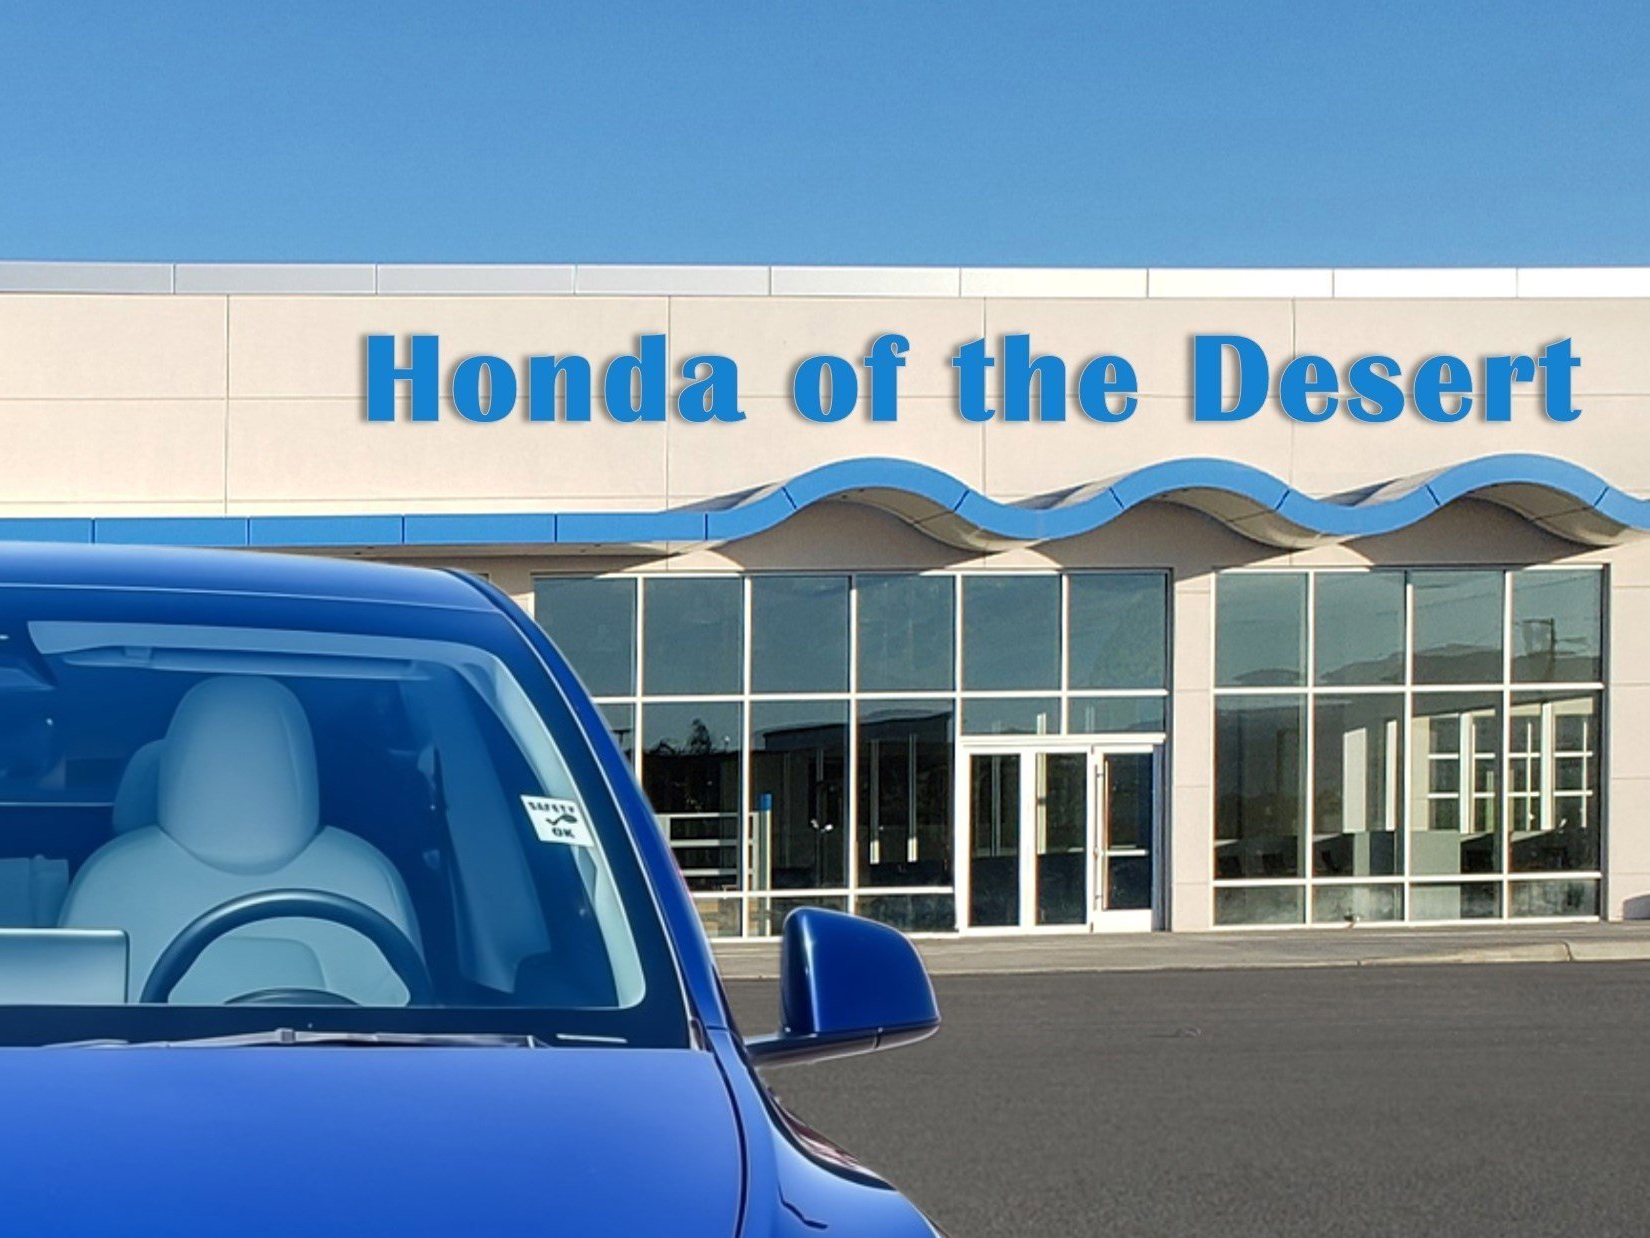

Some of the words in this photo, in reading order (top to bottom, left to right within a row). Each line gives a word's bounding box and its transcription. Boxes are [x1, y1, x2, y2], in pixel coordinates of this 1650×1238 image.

[367, 333, 747, 423] Honda
[794, 333, 911, 423] of
[952, 334, 1138, 423] the
[1194, 335, 1582, 423] Desert
